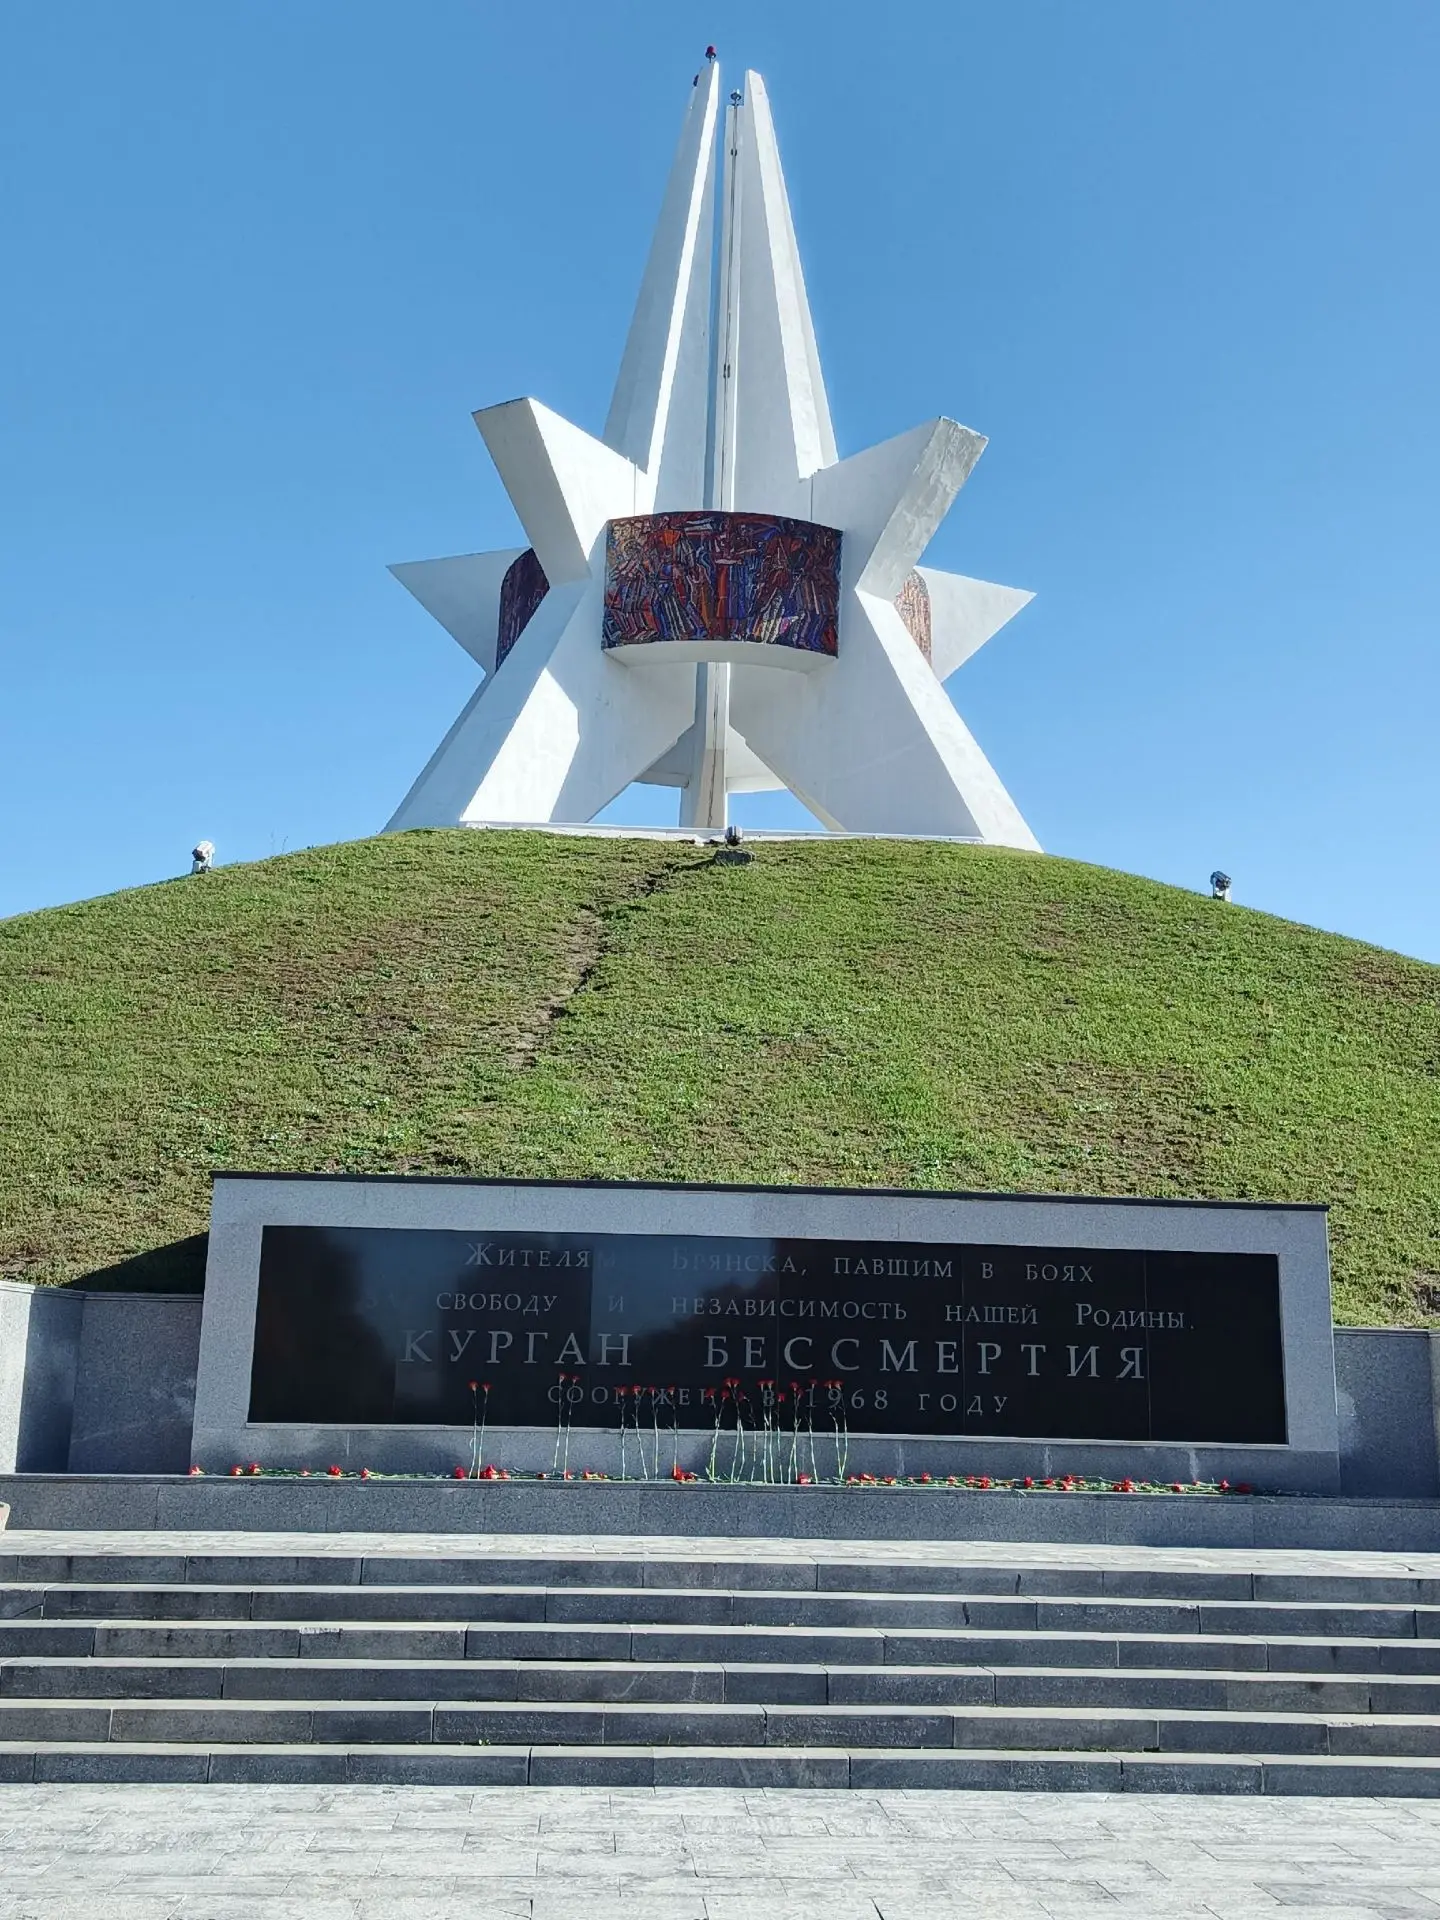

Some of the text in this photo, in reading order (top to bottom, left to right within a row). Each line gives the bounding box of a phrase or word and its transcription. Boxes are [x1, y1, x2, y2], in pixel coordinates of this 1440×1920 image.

[834, 1257, 953, 1278] ПАВШИМ
[981, 1262, 994, 1279] В
[1026, 1264, 1094, 1283] БОЯХ
[436, 1292, 558, 1316] СВОБОДУ
[608, 1295, 625, 1313] И
[671, 1297, 908, 1320] НЕЗАВИСИМОСТЬ
[945, 1303, 1039, 1325] НАШЕЙ
[401, 1329, 1145, 1380] КУРГАН БЕССМЕРТИЯ
[805, 1388, 888, 1410] 1968
[919, 1394, 1008, 1416] ГОДУ
